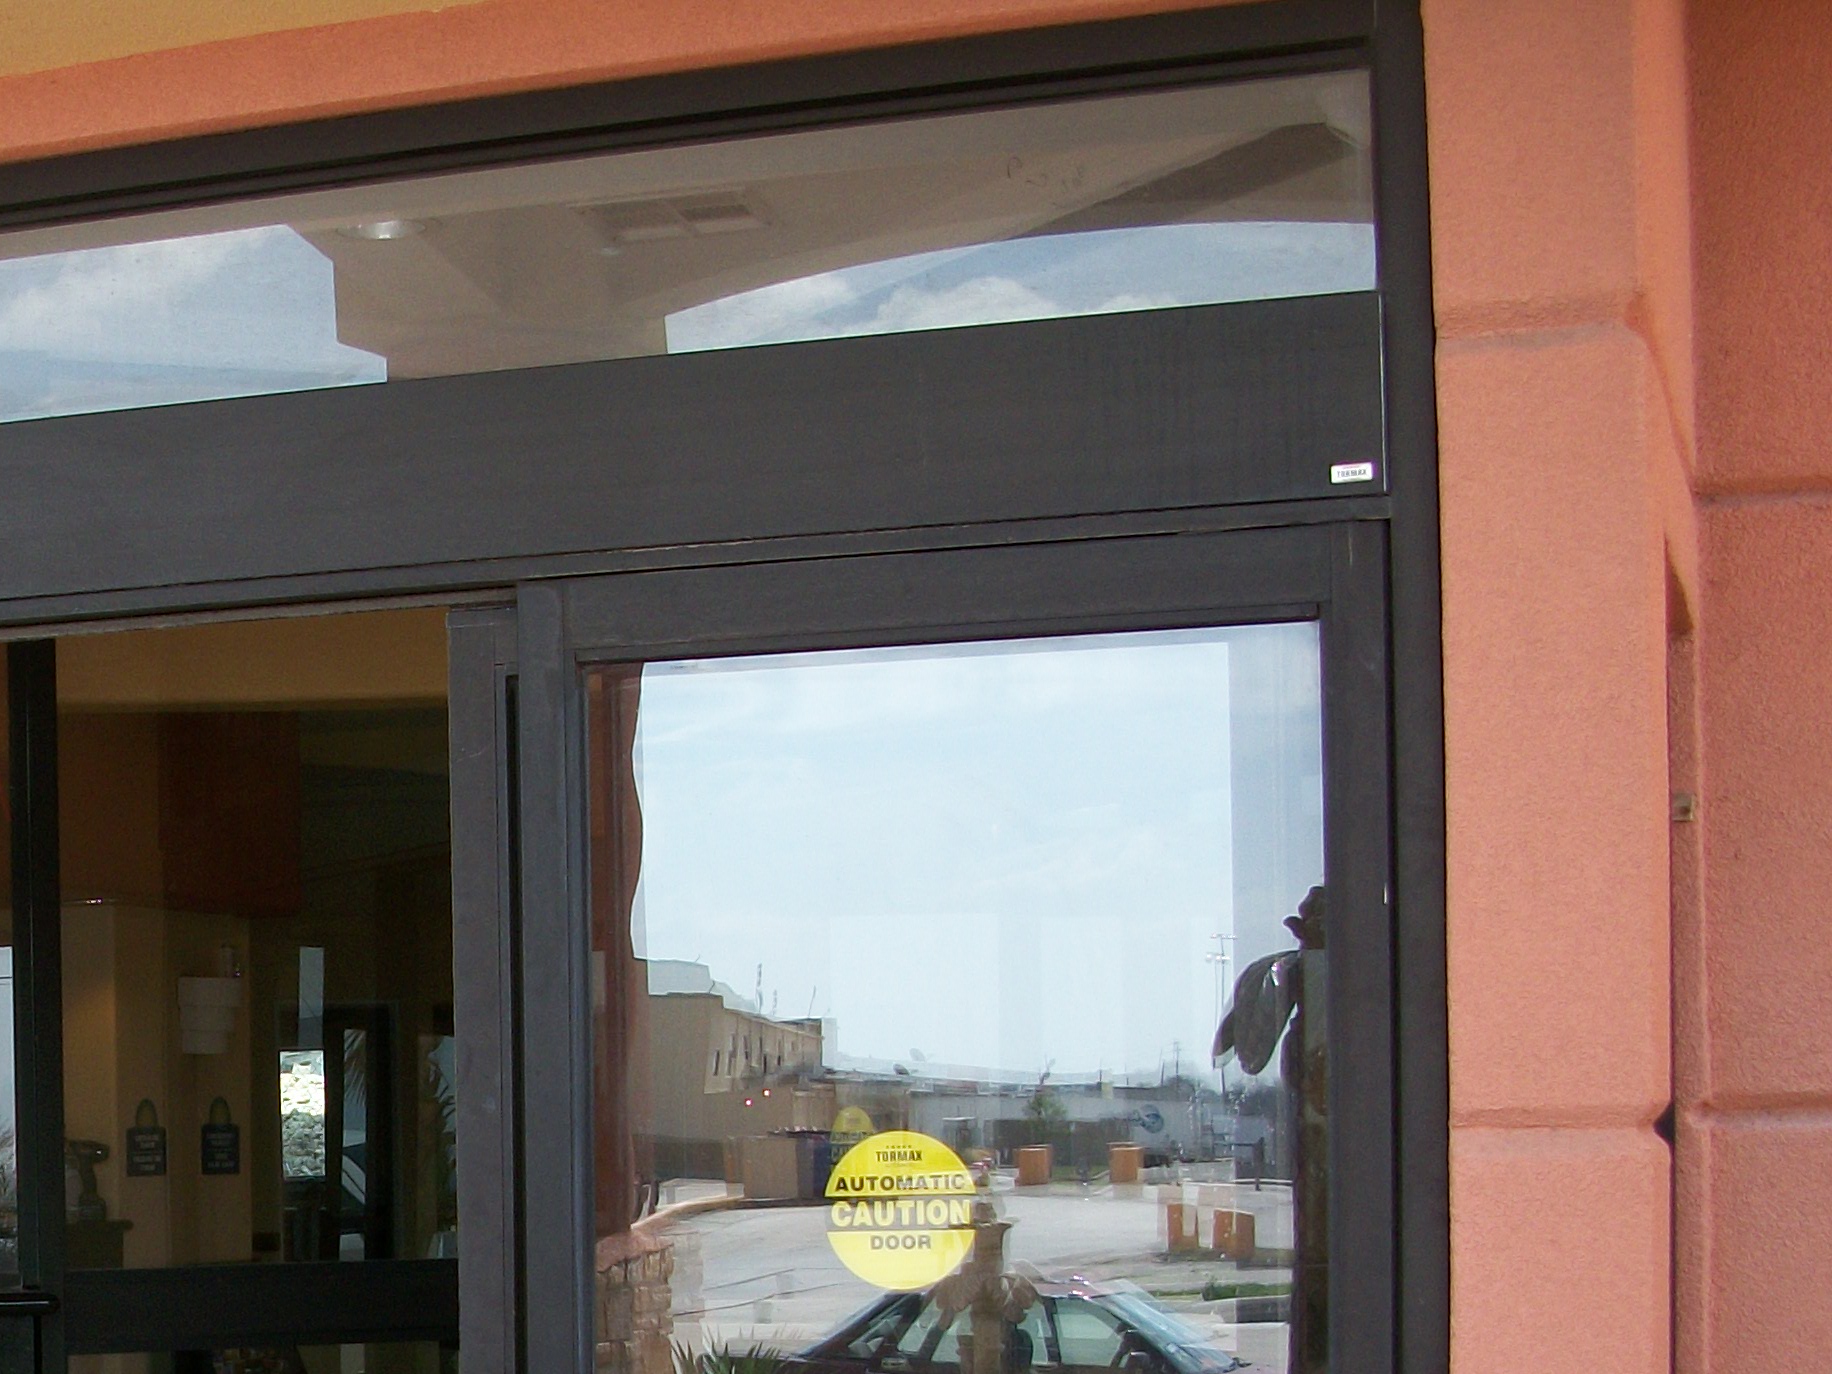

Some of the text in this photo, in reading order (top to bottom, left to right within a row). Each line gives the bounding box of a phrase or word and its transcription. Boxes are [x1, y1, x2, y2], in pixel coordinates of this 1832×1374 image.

[876, 1150, 923, 1162] TORMAX
[835, 1174, 965, 1192] AUTOMATIC
[830, 1199, 970, 1227] CAUTION
[870, 1234, 931, 1250] DOOR
